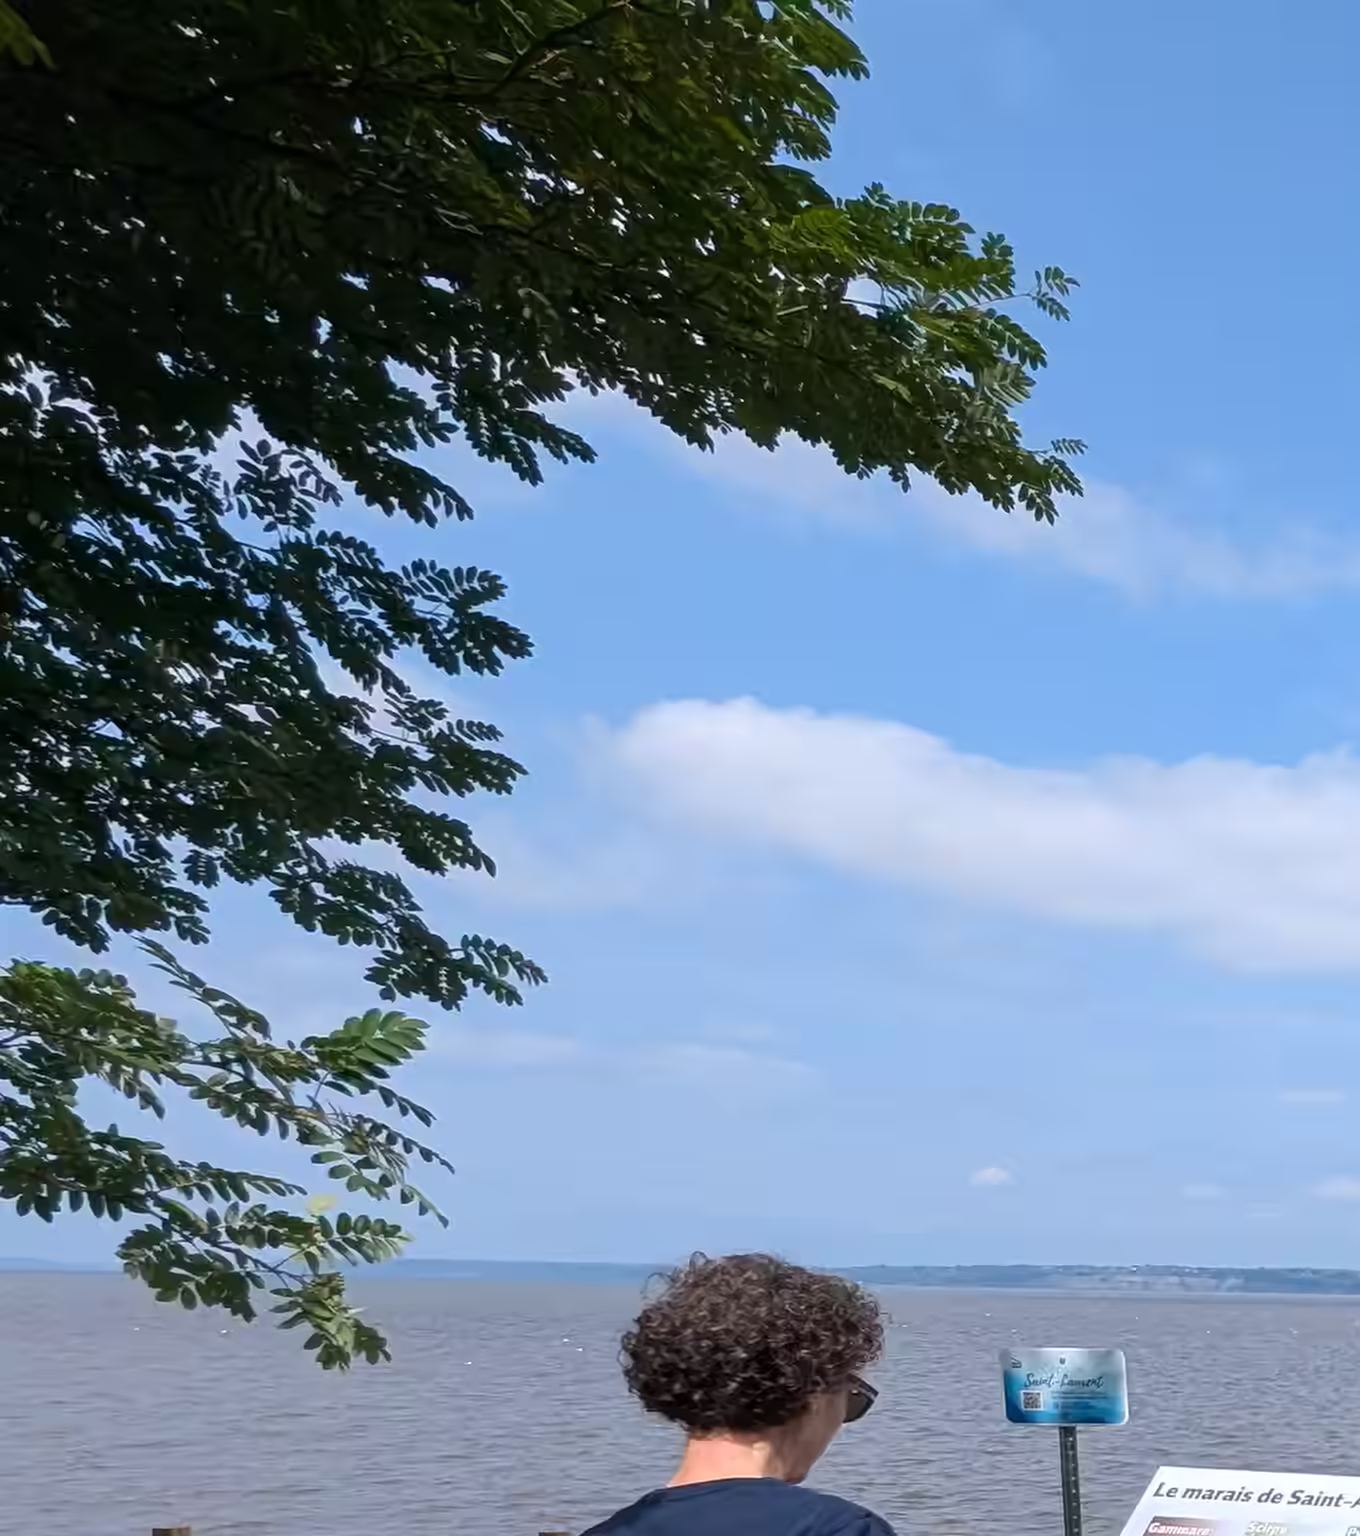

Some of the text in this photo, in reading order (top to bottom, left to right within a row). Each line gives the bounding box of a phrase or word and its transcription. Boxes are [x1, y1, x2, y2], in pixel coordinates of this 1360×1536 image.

[1024, 1372, 1105, 1388] Saint-Laurent
[1153, 1482, 1179, 1498] Le
[1181, 1486, 1254, 1503] marais
[1257, 1488, 1283, 1505] de
